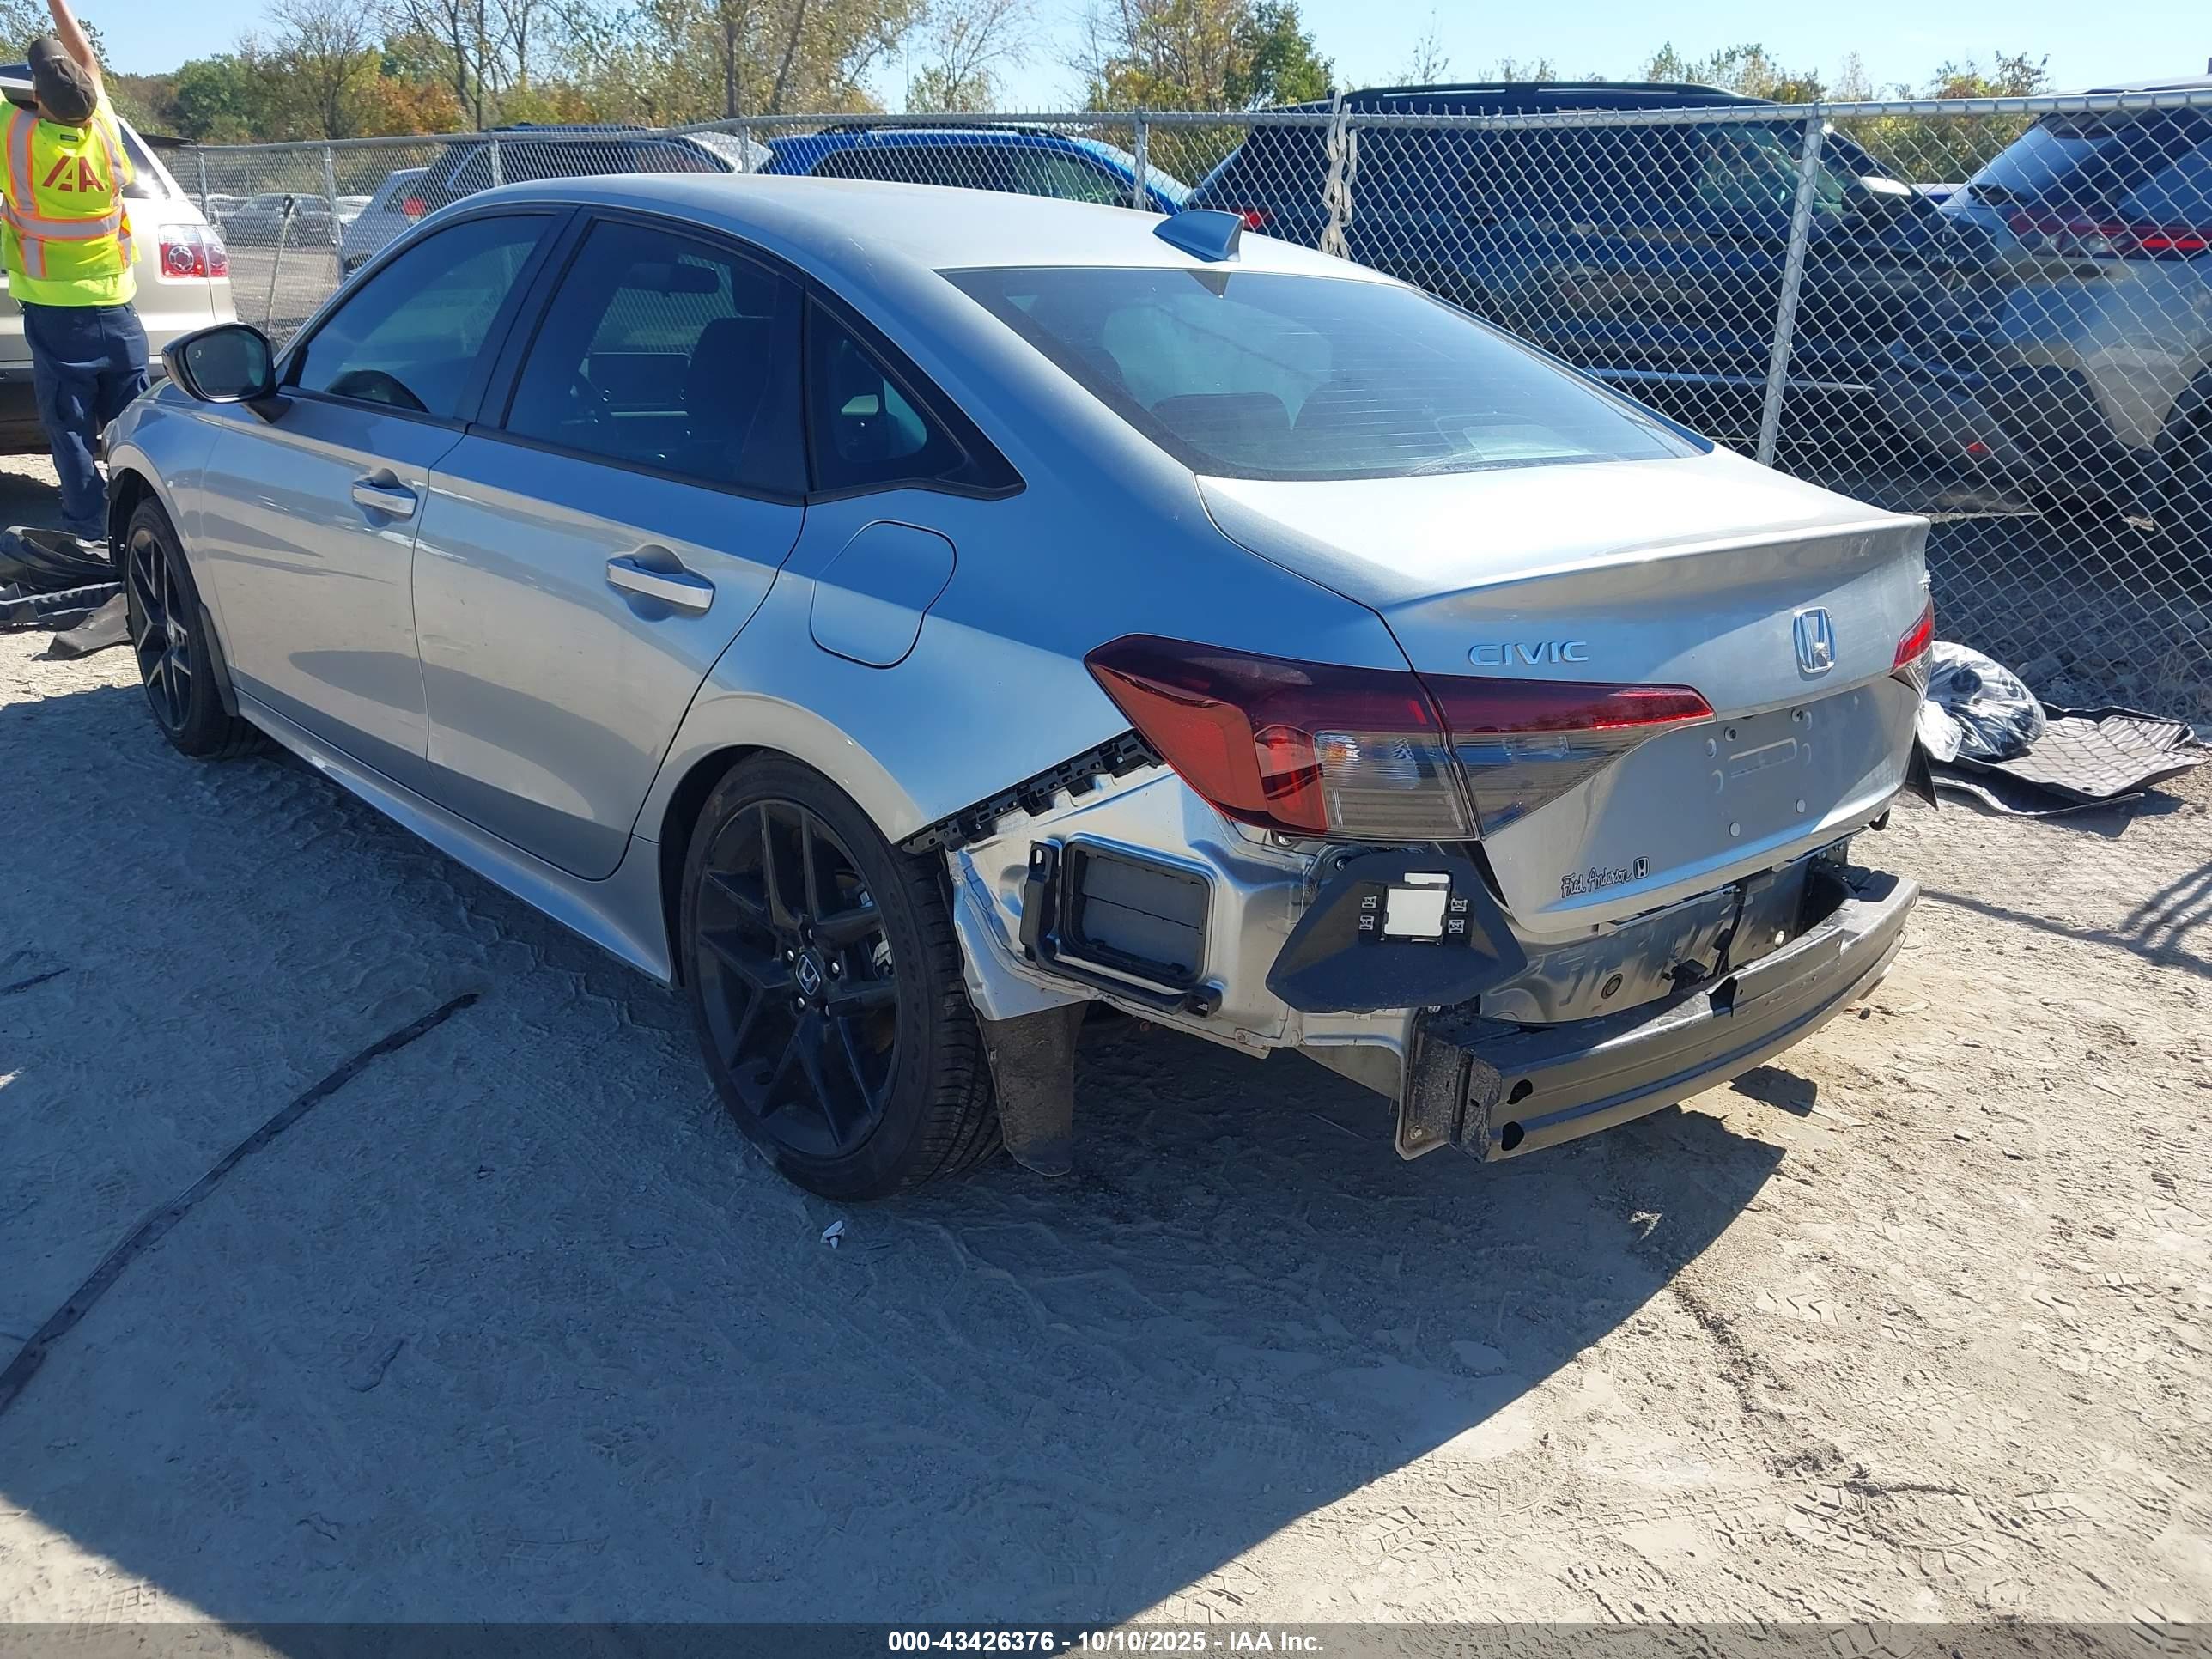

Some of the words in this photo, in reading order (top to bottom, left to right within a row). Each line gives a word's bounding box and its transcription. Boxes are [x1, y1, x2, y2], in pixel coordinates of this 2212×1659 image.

[1468, 641, 1589, 666] CIVIC
[1560, 872, 1586, 899] Fred
[1587, 866, 1632, 893] Anderson
